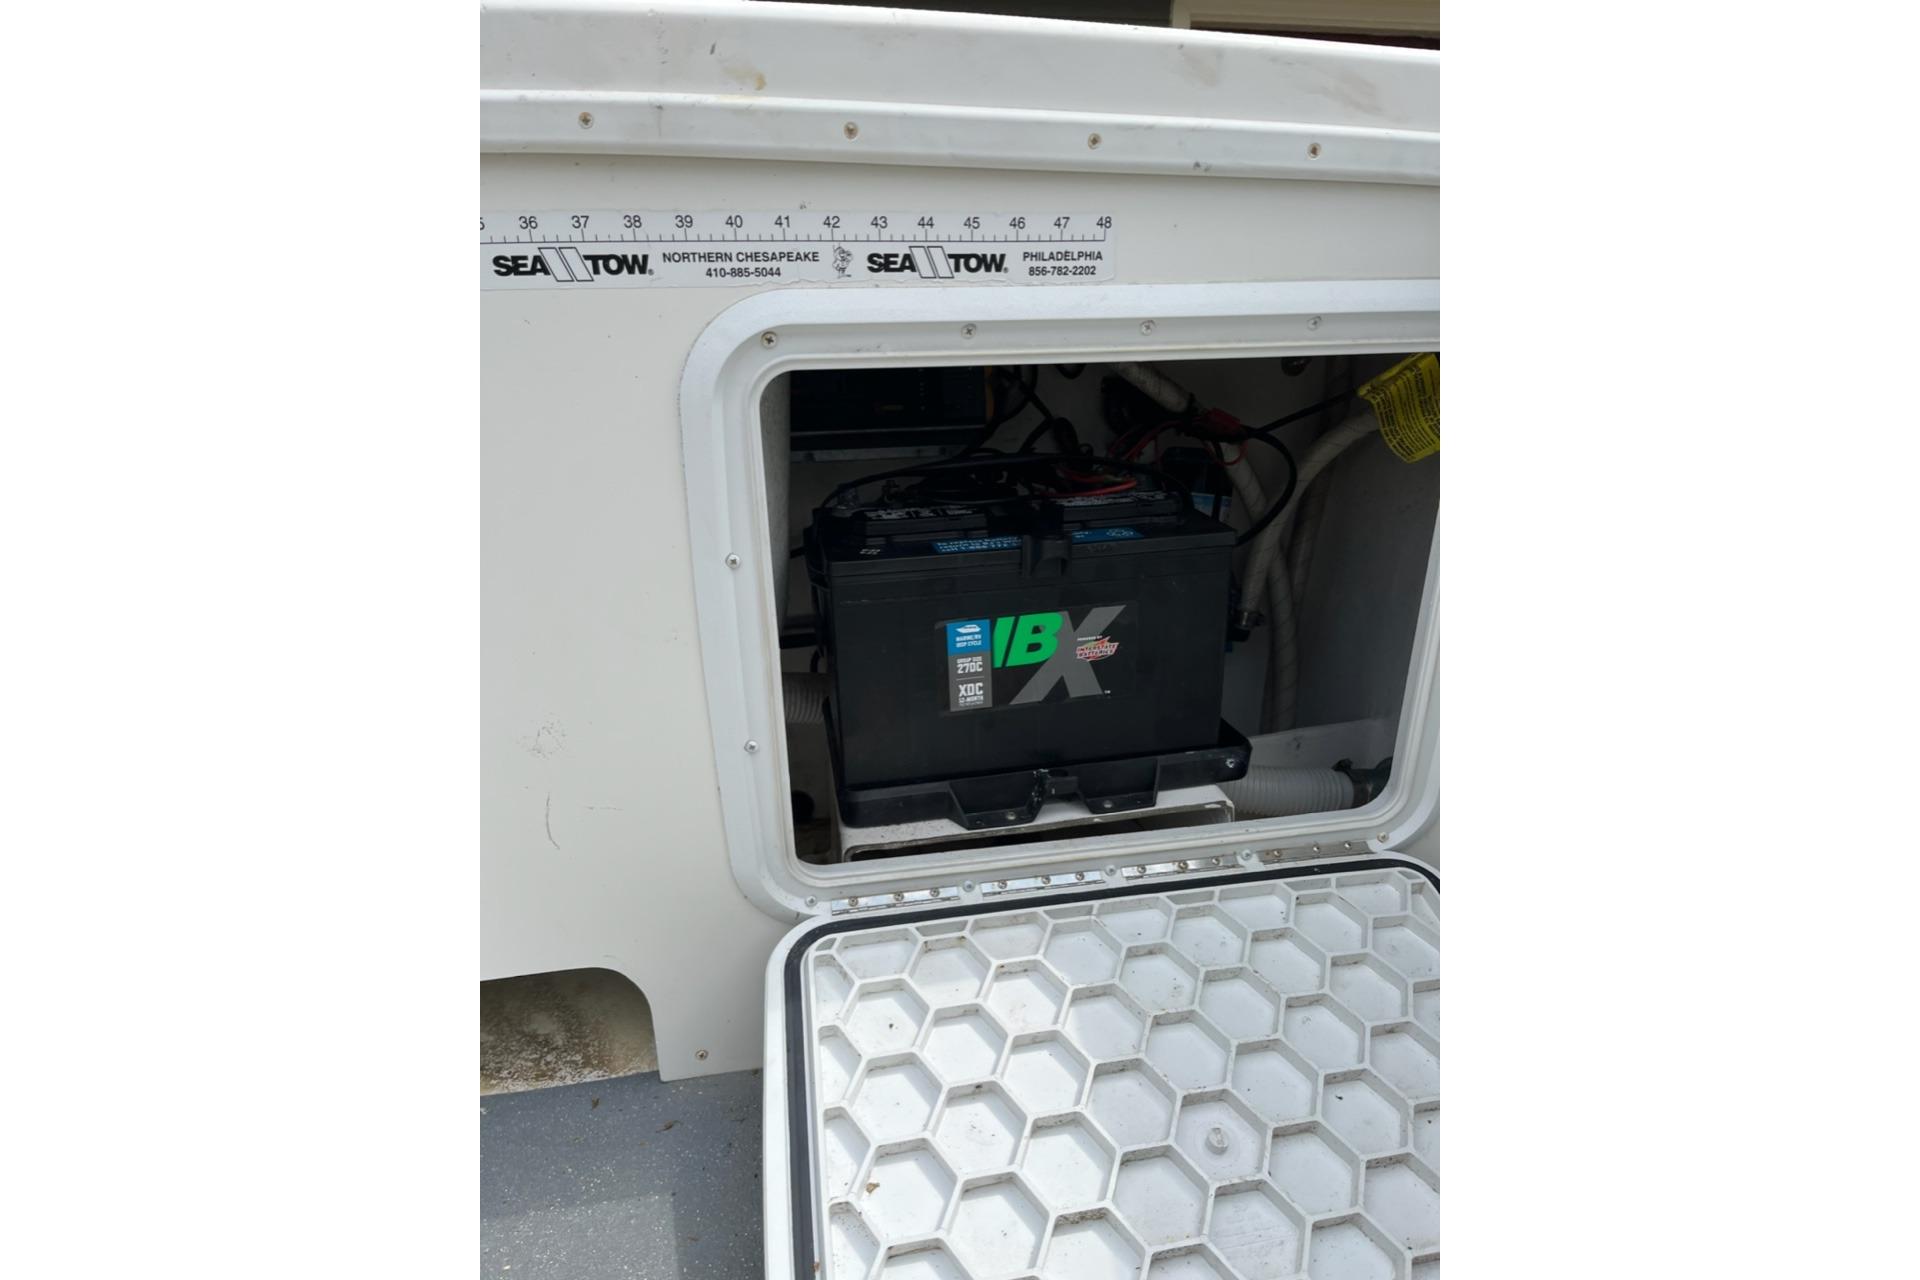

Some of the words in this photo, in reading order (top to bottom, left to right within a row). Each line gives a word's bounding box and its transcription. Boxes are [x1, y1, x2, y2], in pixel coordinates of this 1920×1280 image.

[518, 216, 538, 230] 36
[571, 215, 590, 229] 37
[623, 215, 642, 229] 38
[675, 214, 694, 229] 39
[725, 215, 743, 229] 40
[774, 215, 791, 229] 41
[823, 216, 841, 229] 42
[870, 216, 888, 229] 43
[917, 216, 935, 229] 44
[963, 217, 980, 229] 45
[1009, 217, 1026, 230] 46
[1053, 217, 1070, 229] 47
[1096, 216, 1112, 229] 48
[662, 252, 734, 263] NORTHERN
[736, 251, 820, 263] CHESAPEAKE
[1023, 250, 1103, 262] PHILADELPHIA
[492, 254, 551, 277] SEA
[867, 253, 917, 273] SEA
[706, 267, 781, 279] 410-885-5044
[1028, 265, 1097, 276] 856-782-2202
[956, 661, 983, 674] 27DC
[958, 682, 984, 697] XDC
